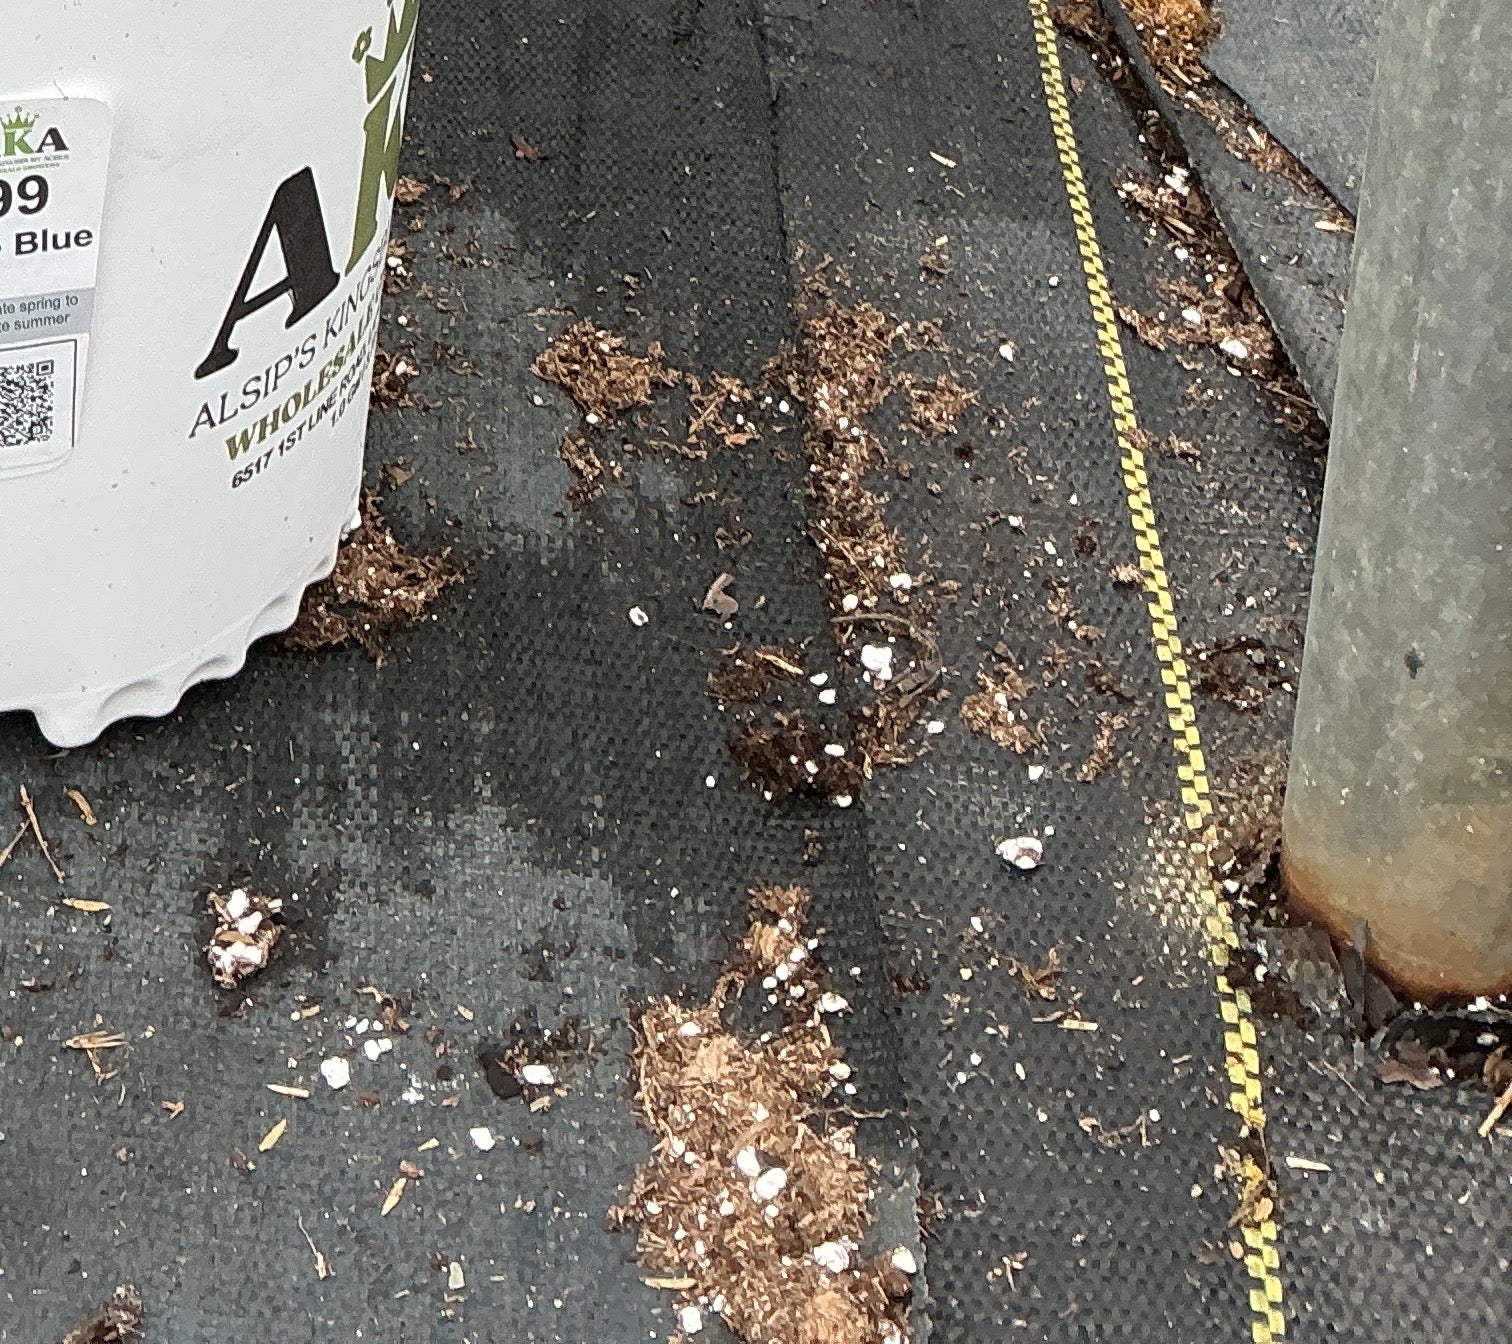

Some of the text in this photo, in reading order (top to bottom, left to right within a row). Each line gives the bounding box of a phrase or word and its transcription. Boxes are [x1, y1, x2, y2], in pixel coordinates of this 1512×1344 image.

[15, 228, 94, 256] Blue
[19, 296, 61, 315] spring
[65, 294, 79, 307] to
[14, 313, 71, 331] summer
[188, 333, 316, 439] ALSIP'S
[231, 447, 273, 489] 6517
[278, 418, 307, 457] 1ST
